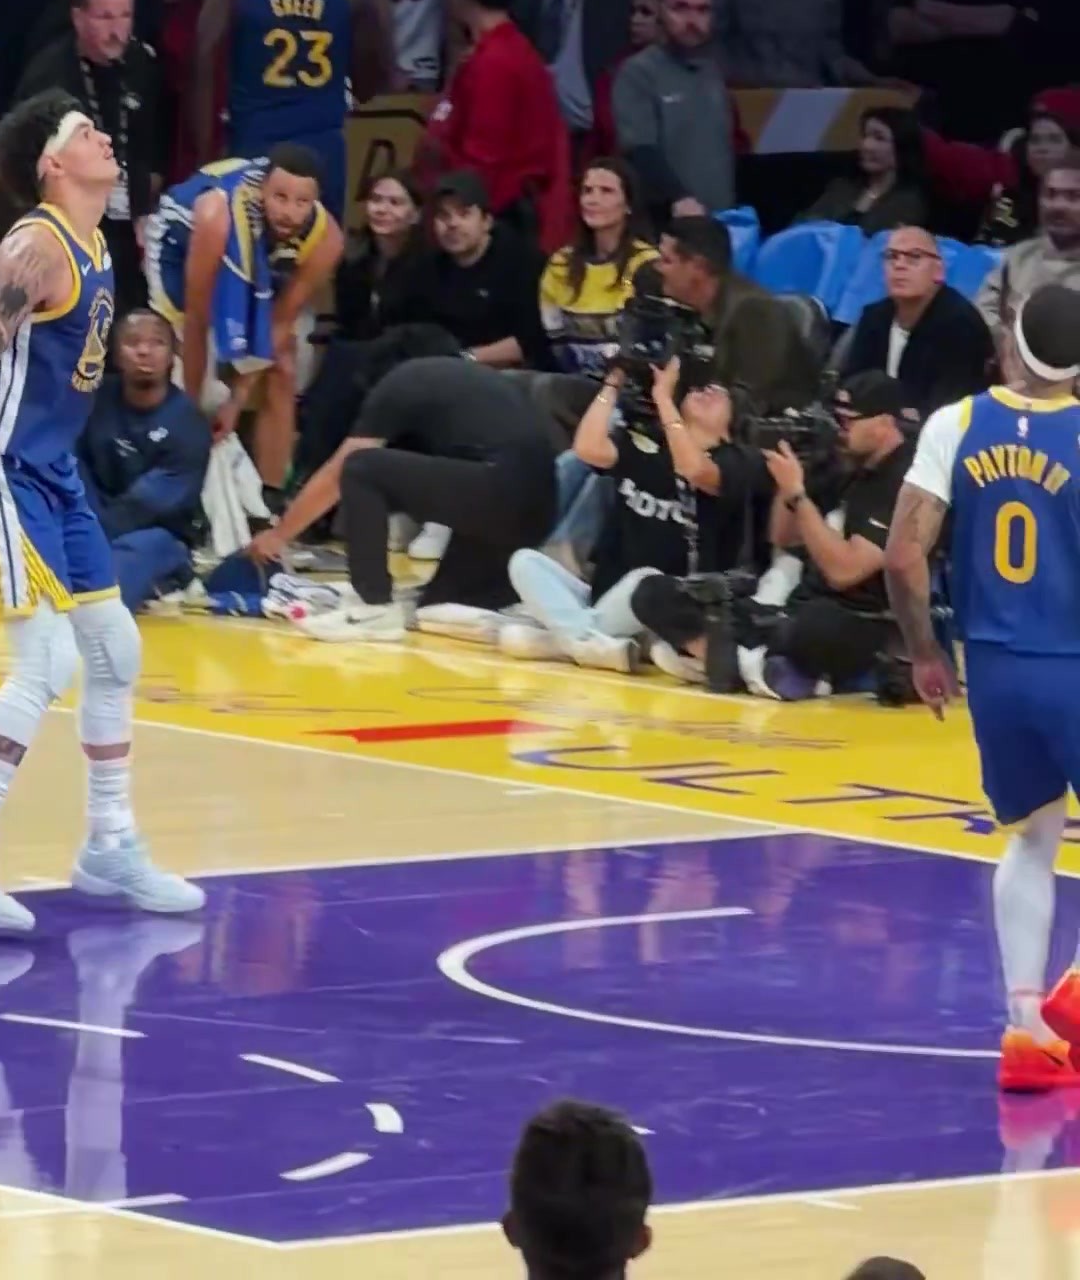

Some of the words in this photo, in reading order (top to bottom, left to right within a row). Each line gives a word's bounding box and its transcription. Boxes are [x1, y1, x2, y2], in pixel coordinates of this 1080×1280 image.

[262, 28, 333, 87] 23
[963, 444, 1049, 488] PAYTON
[994, 500, 1038, 585] 0
